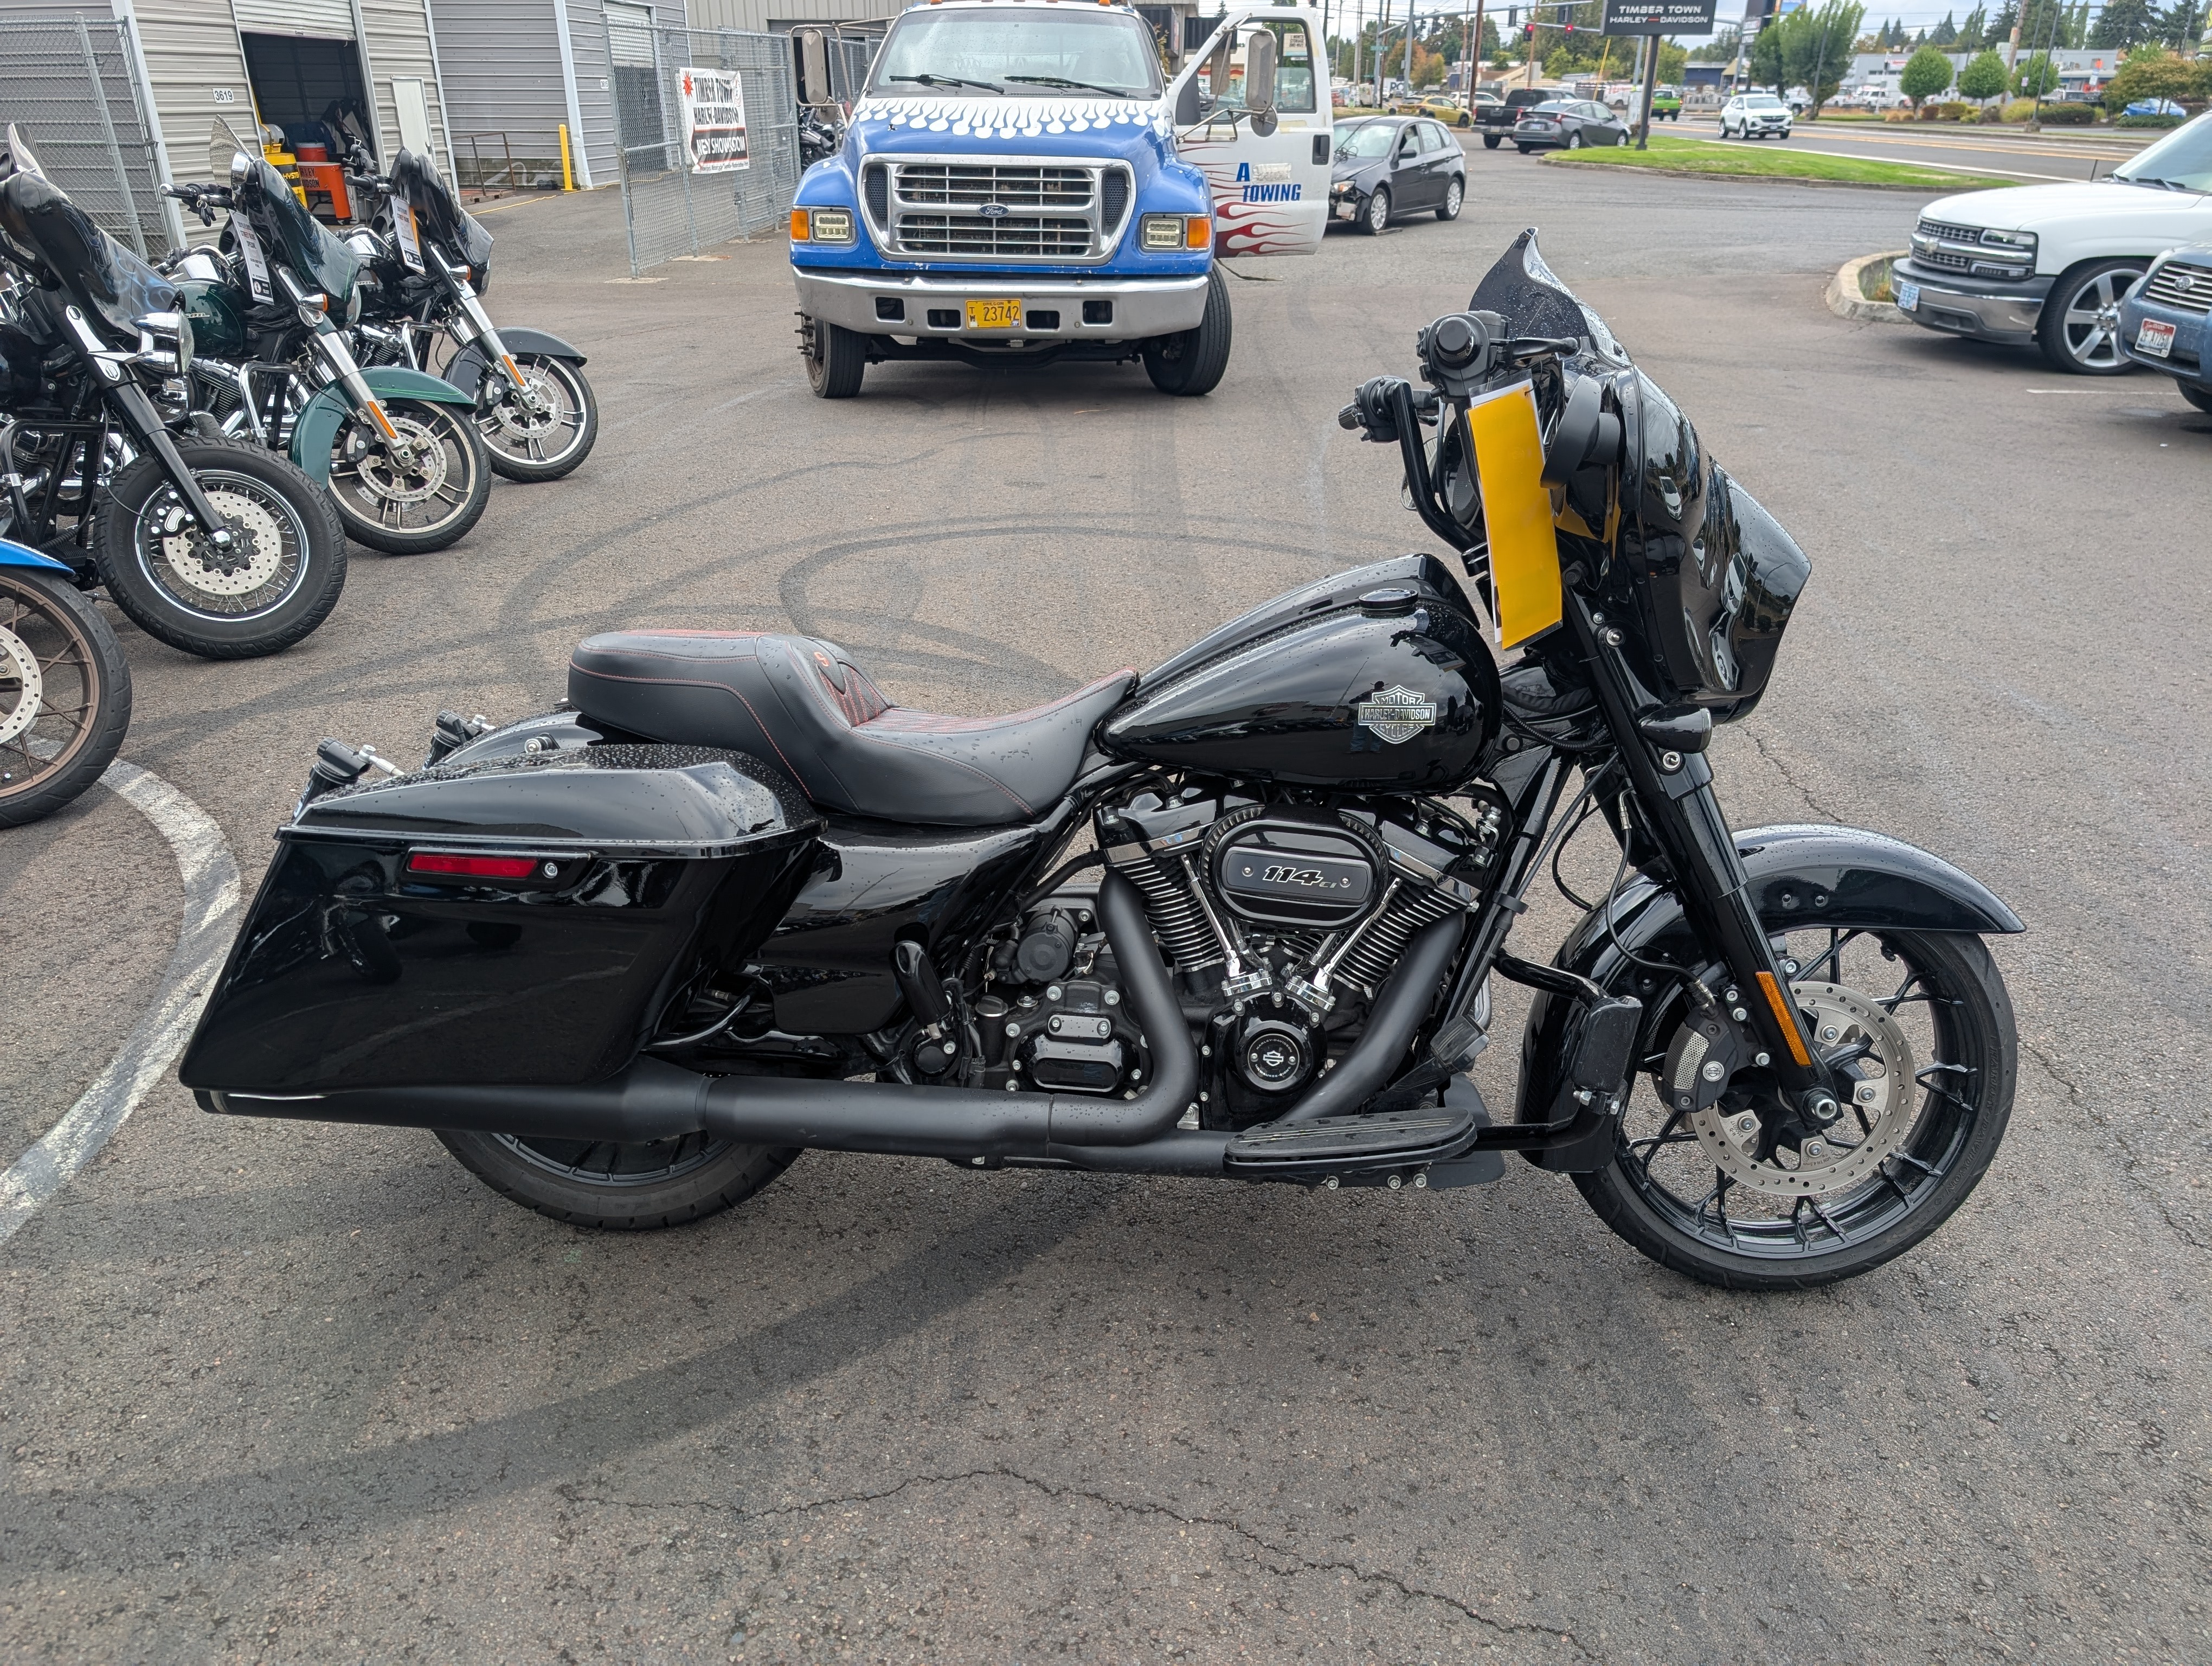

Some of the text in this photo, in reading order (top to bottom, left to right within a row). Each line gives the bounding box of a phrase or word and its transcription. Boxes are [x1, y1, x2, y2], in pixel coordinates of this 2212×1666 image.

[1668, 5, 1702, 14] TOWN
[214, 90, 233, 101] 3619
[693, 77, 716, 103] TIMBER
[1236, 163, 1250, 182] A
[1243, 184, 1302, 203] TOWING
[985, 206, 1004, 215] Ford
[983, 305, 1020, 322] 23742
[1381, 691, 1416, 705] MOTOR
[1364, 708, 1431, 721] HARLEY-DAVIDSON
[1379, 723, 1415, 738] CYCLES
[1256, 1038, 1293, 1053] HARLEY-DAVIDSON
[1255, 1063, 1292, 1078] MILWAUKEE-EIGHT
